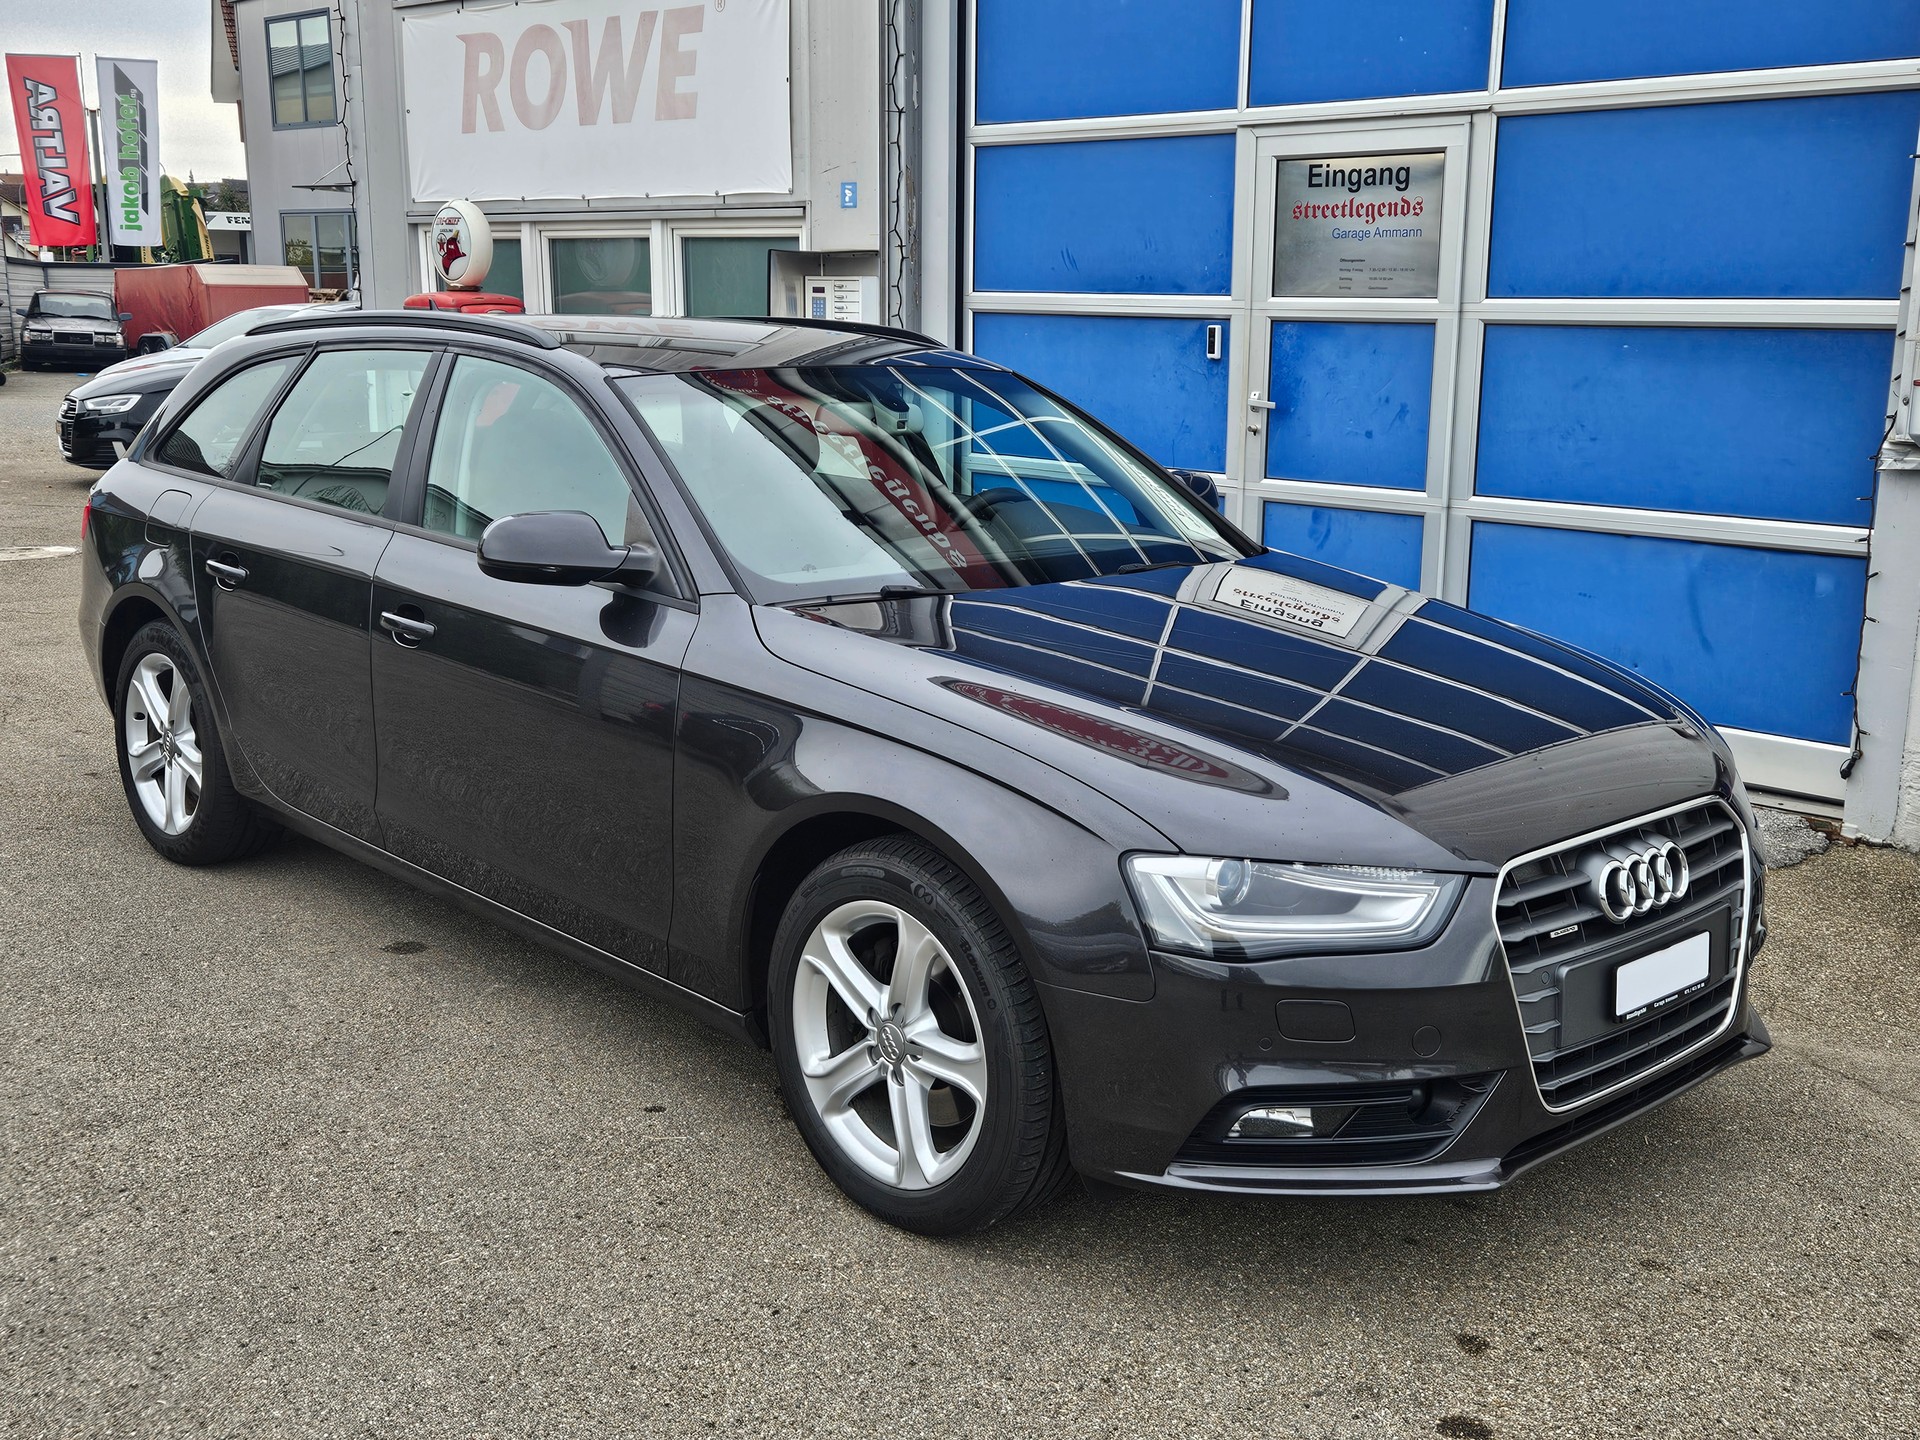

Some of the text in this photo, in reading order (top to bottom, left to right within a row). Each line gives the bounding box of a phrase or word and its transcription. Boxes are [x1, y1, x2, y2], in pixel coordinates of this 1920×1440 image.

[456, 4, 705, 134] ROWE
[116, 94, 140, 160] hofer
[118, 166, 143, 232] jakob
[1308, 163, 1411, 193] Eingang
[1292, 195, 1424, 225] streetlegends
[1331, 227, 1423, 242] Garage Ammann
